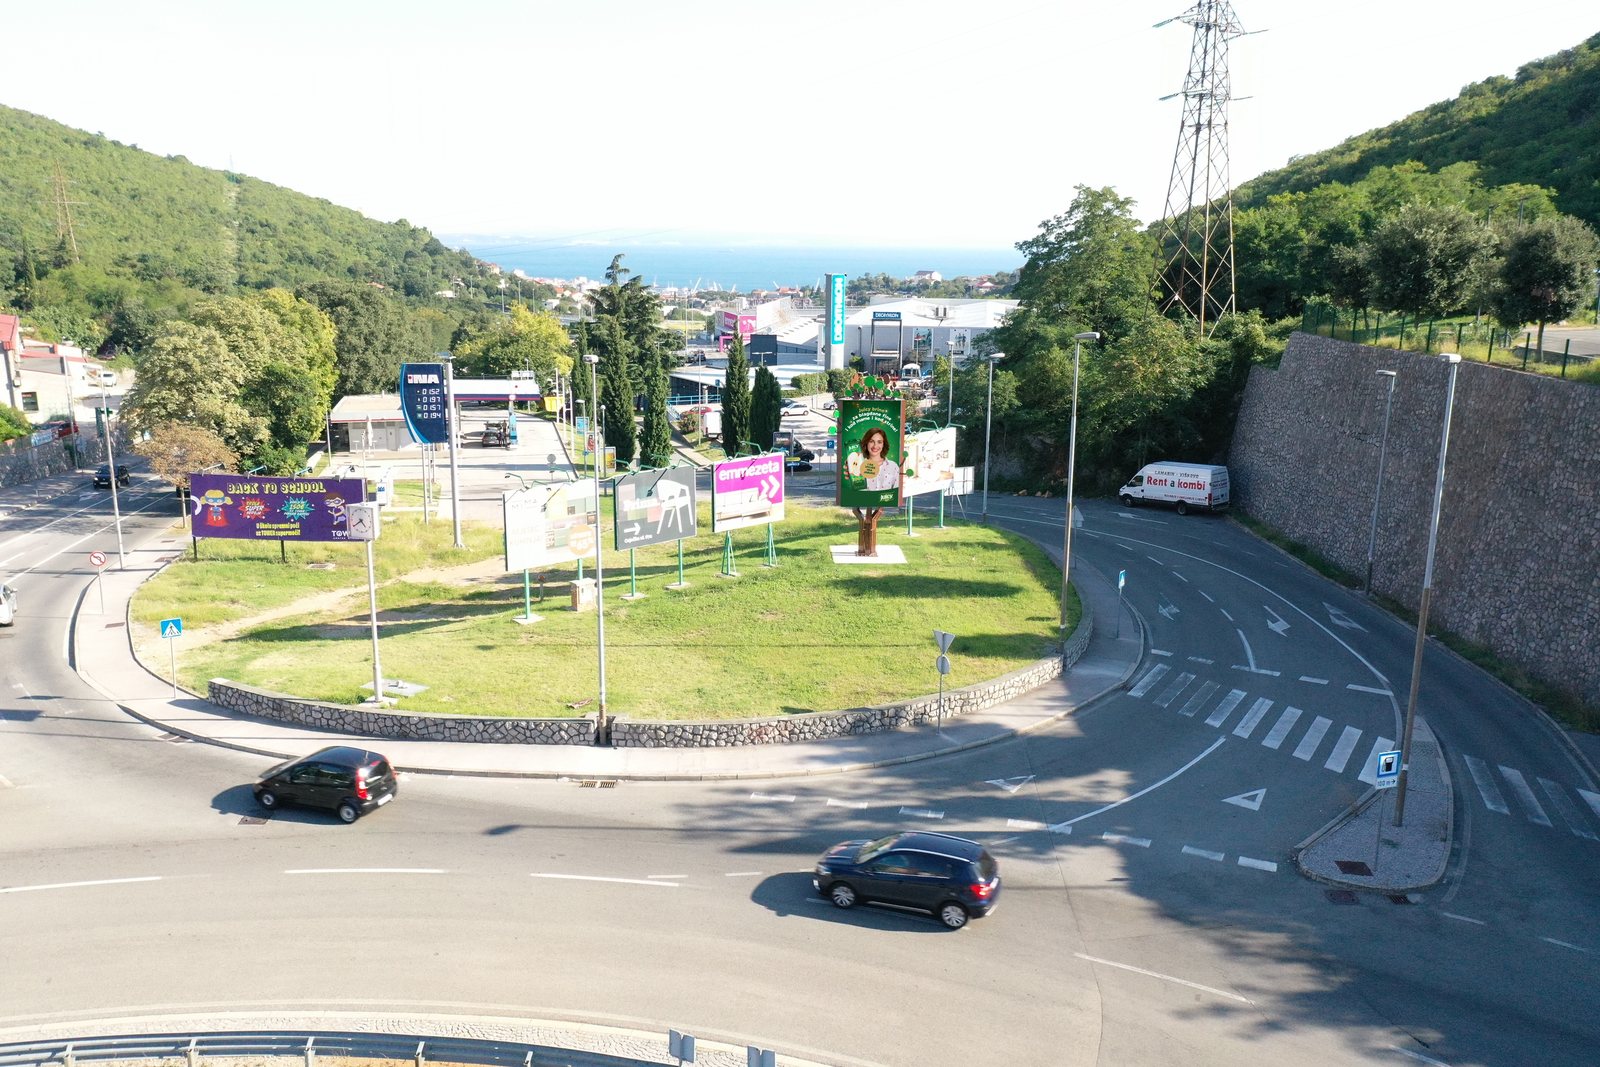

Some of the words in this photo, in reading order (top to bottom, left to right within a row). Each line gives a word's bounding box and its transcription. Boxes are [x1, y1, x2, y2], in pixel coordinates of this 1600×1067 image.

[408, 374, 440, 384] INA
[719, 460, 780, 481] emmezeta
[228, 482, 259, 494] BACK
[262, 483, 278, 494] TO
[280, 482, 327, 494] SCHOOL
[1147, 476, 1168, 486] Rent
[1178, 479, 1206, 490] kombi
